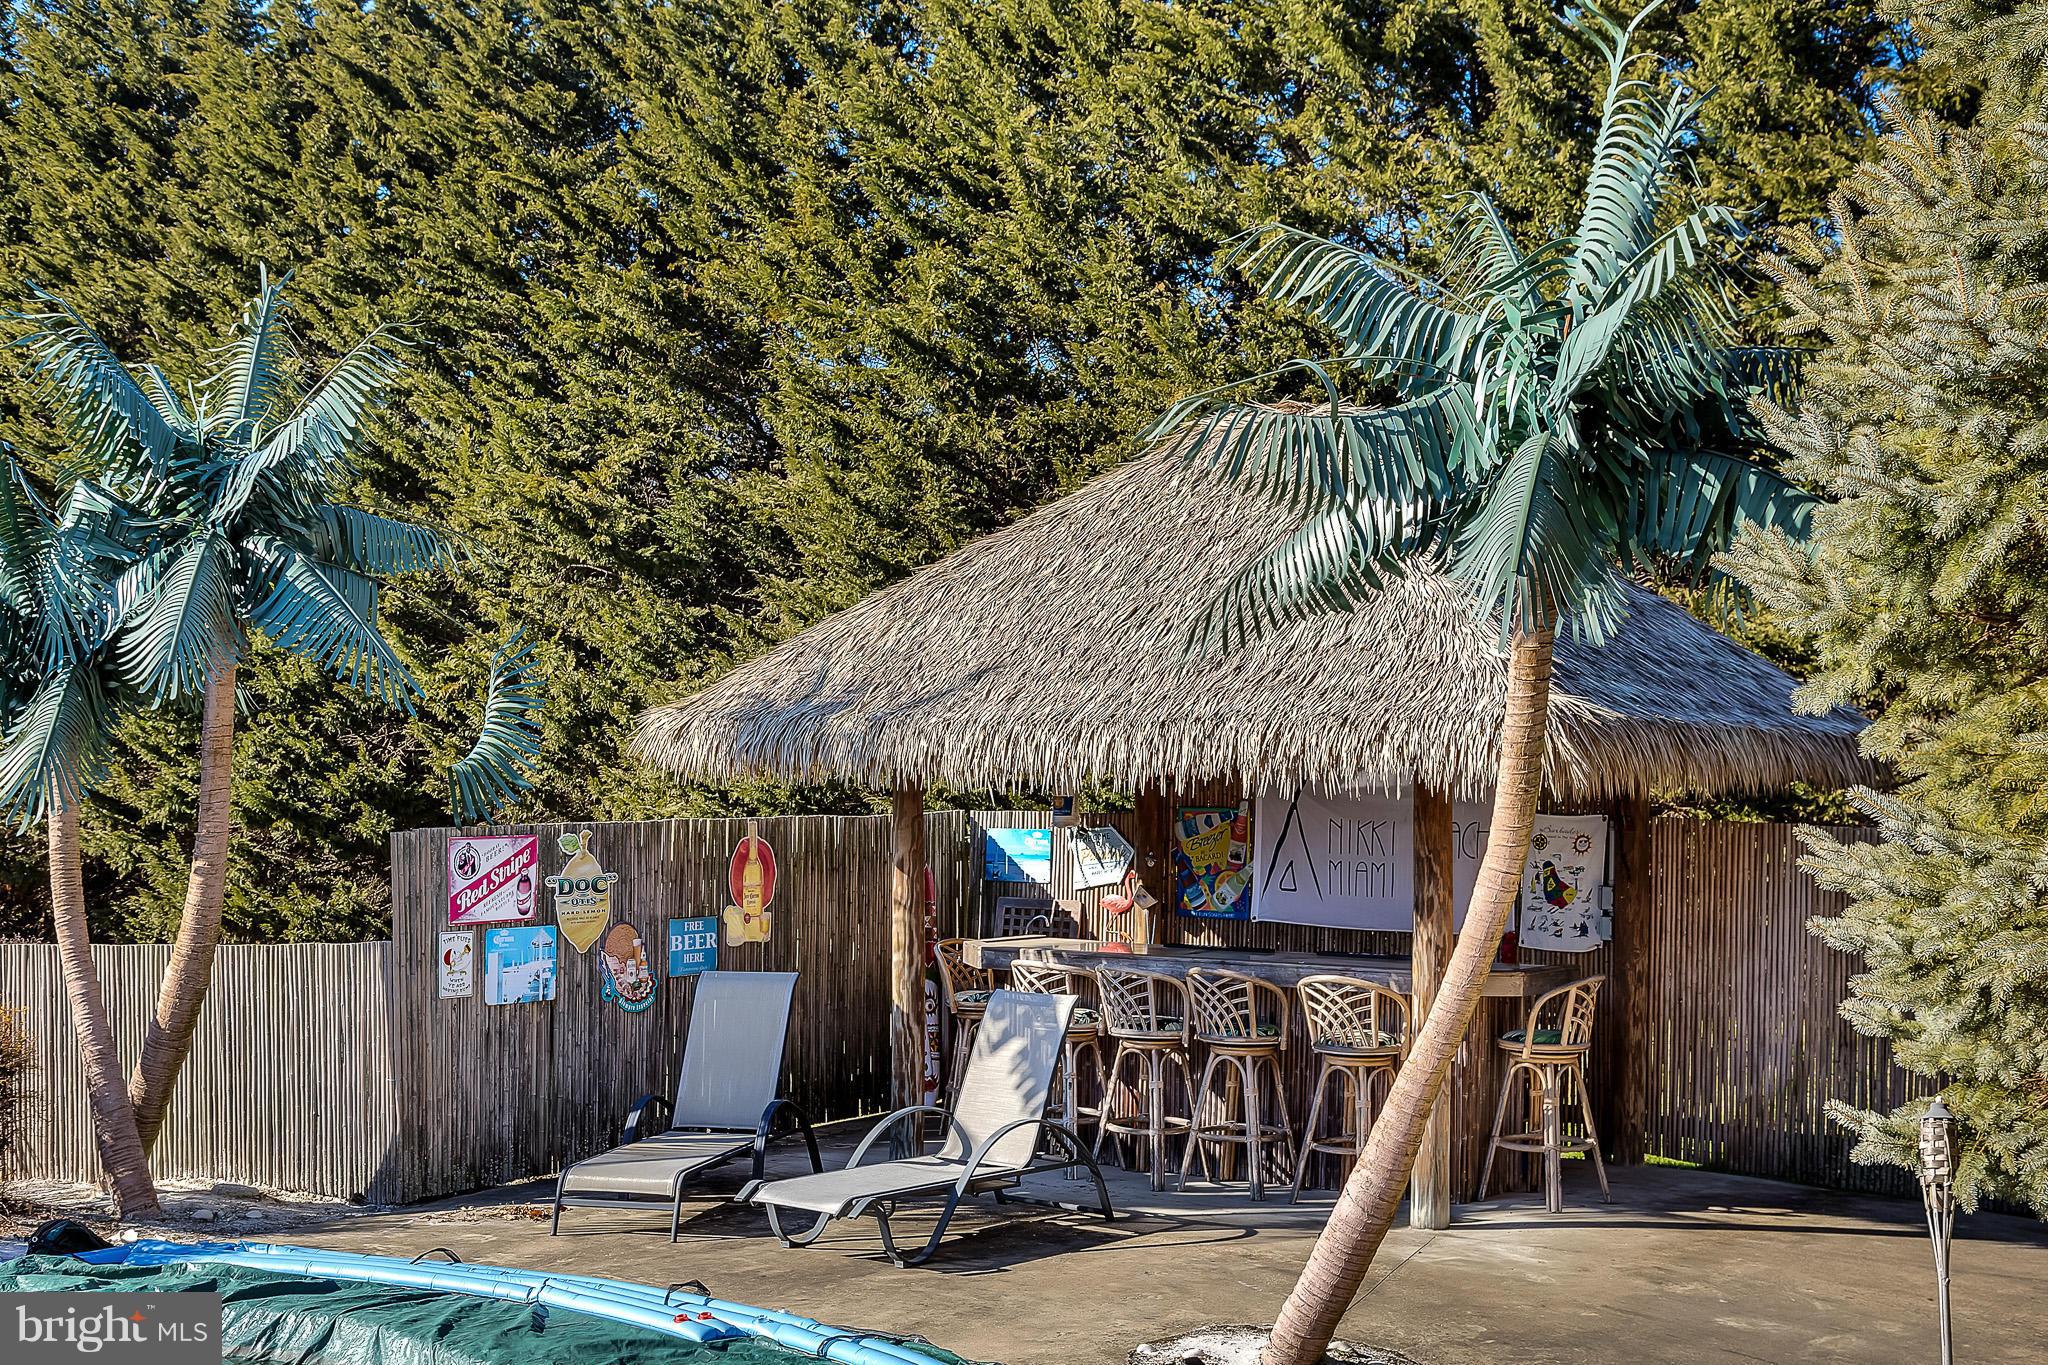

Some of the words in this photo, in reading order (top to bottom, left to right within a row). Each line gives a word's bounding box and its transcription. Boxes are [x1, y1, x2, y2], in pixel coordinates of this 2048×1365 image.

[1328, 818, 1396, 857] NIKKI
[1452, 821, 1490, 860] ACH
[1195, 851, 1224, 862] BACARDI
[456, 879, 490, 913] Red
[489, 849, 531, 890] Stripe
[1328, 860, 1395, 898] MIAMI
[684, 921, 704, 932] FREE
[670, 932, 717, 952] BEER
[683, 952, 705, 963] HERE
